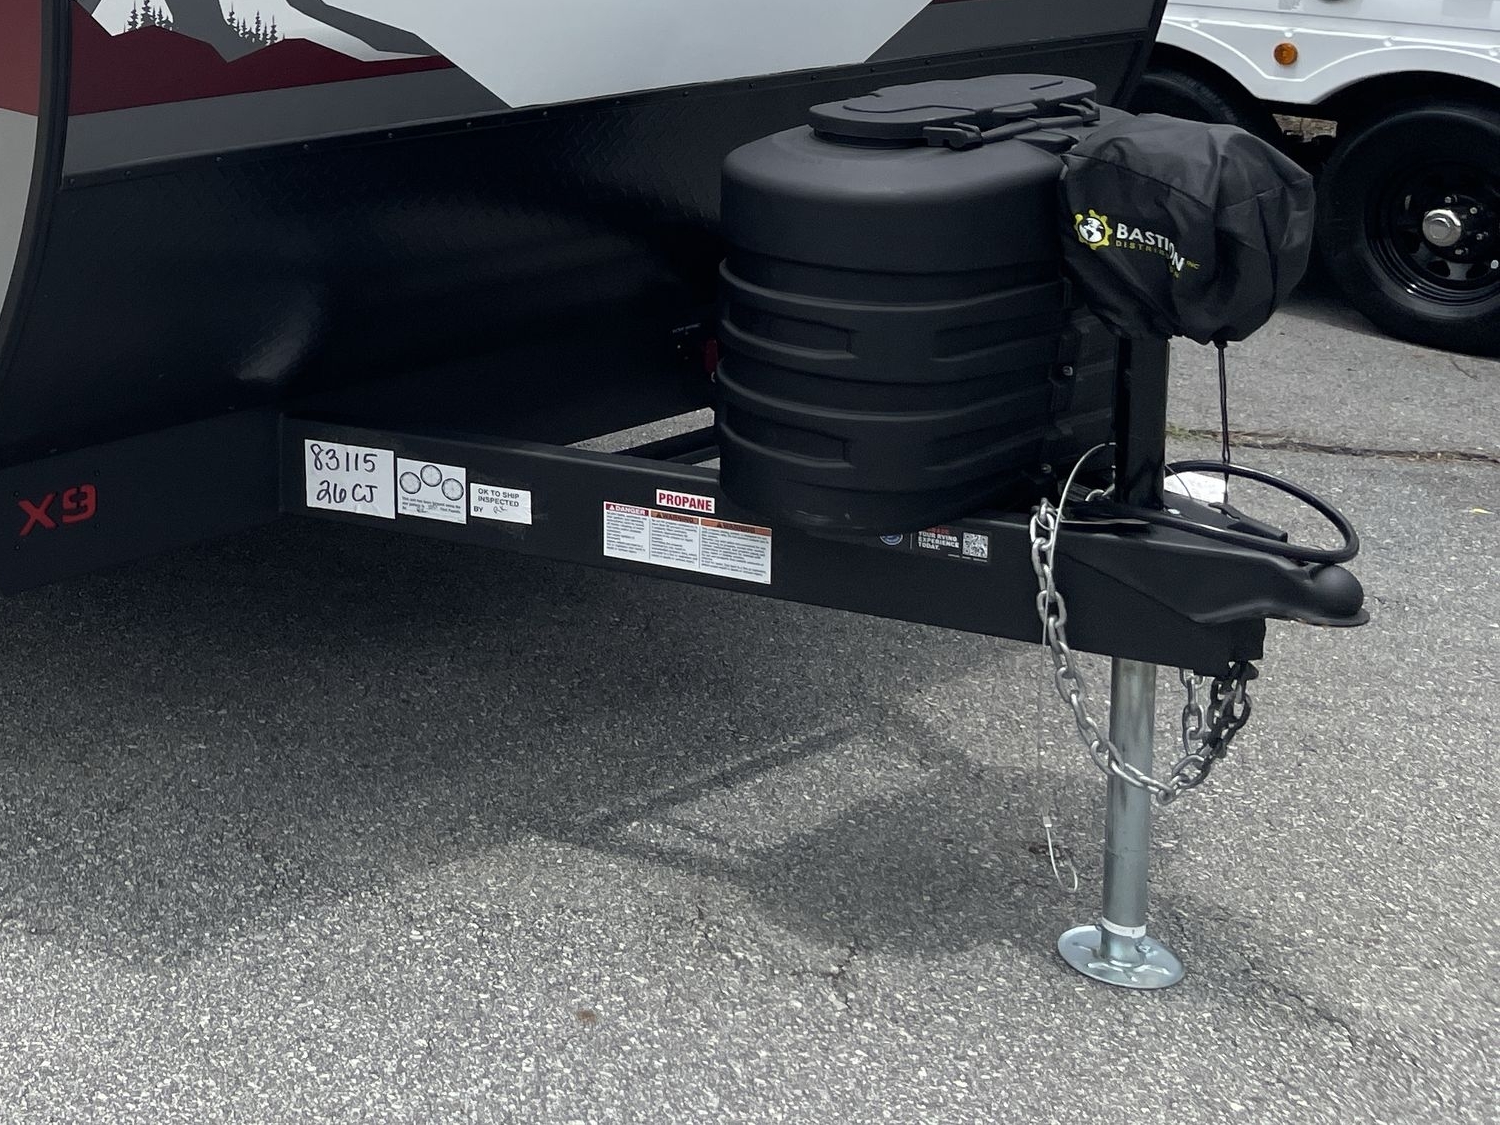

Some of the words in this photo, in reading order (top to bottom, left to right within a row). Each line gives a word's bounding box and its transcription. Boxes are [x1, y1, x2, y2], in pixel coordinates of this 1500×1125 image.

[1116, 222, 1185, 272] BASTION
[310, 443, 378, 473] 83115
[477, 487, 489, 496] OK
[490, 488, 501, 497] TO
[502, 491, 520, 500] SHIP
[477, 495, 520, 508] INSPECTED
[658, 491, 713, 512] PROPANE
[18, 483, 97, 537] X9
[473, 505, 484, 514] BY
[615, 505, 646, 516] DANGER
[917, 536, 960, 549] EXPERIENCE
